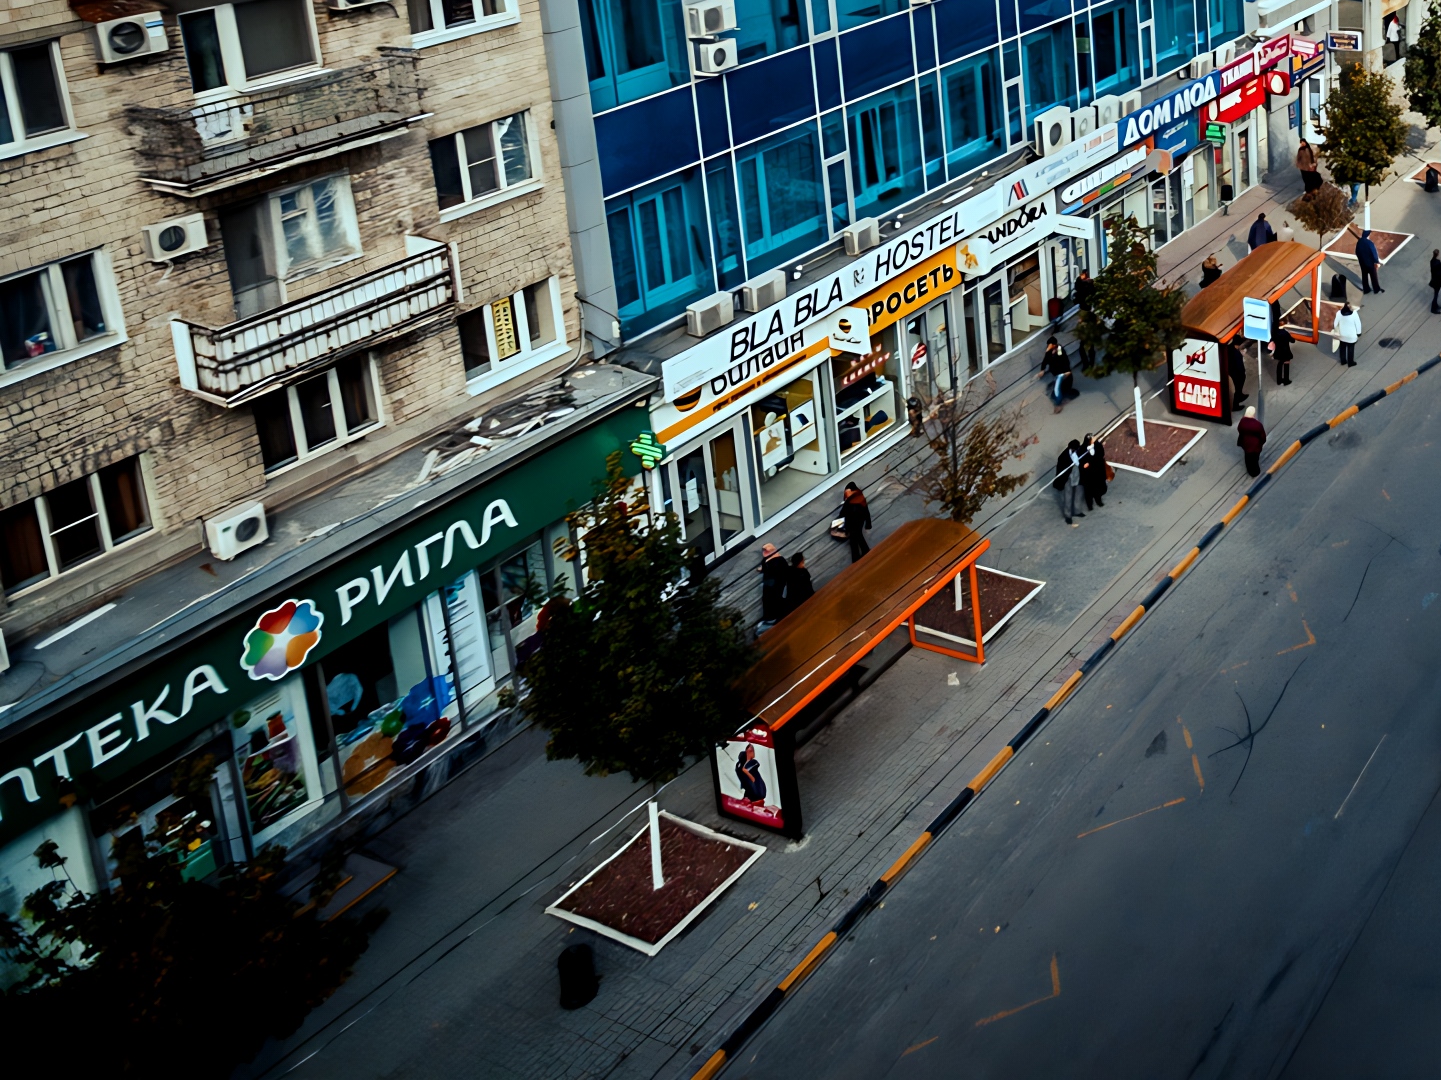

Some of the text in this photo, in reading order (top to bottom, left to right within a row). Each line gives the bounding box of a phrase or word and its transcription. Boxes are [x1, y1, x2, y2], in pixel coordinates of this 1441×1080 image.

[1123, 99, 1171, 147] ДОМ
[730, 212, 965, 362] BLA BLA HOSTEL
[866, 264, 954, 326] РОСЕТЬ
[334, 498, 518, 625] РИГЛА
